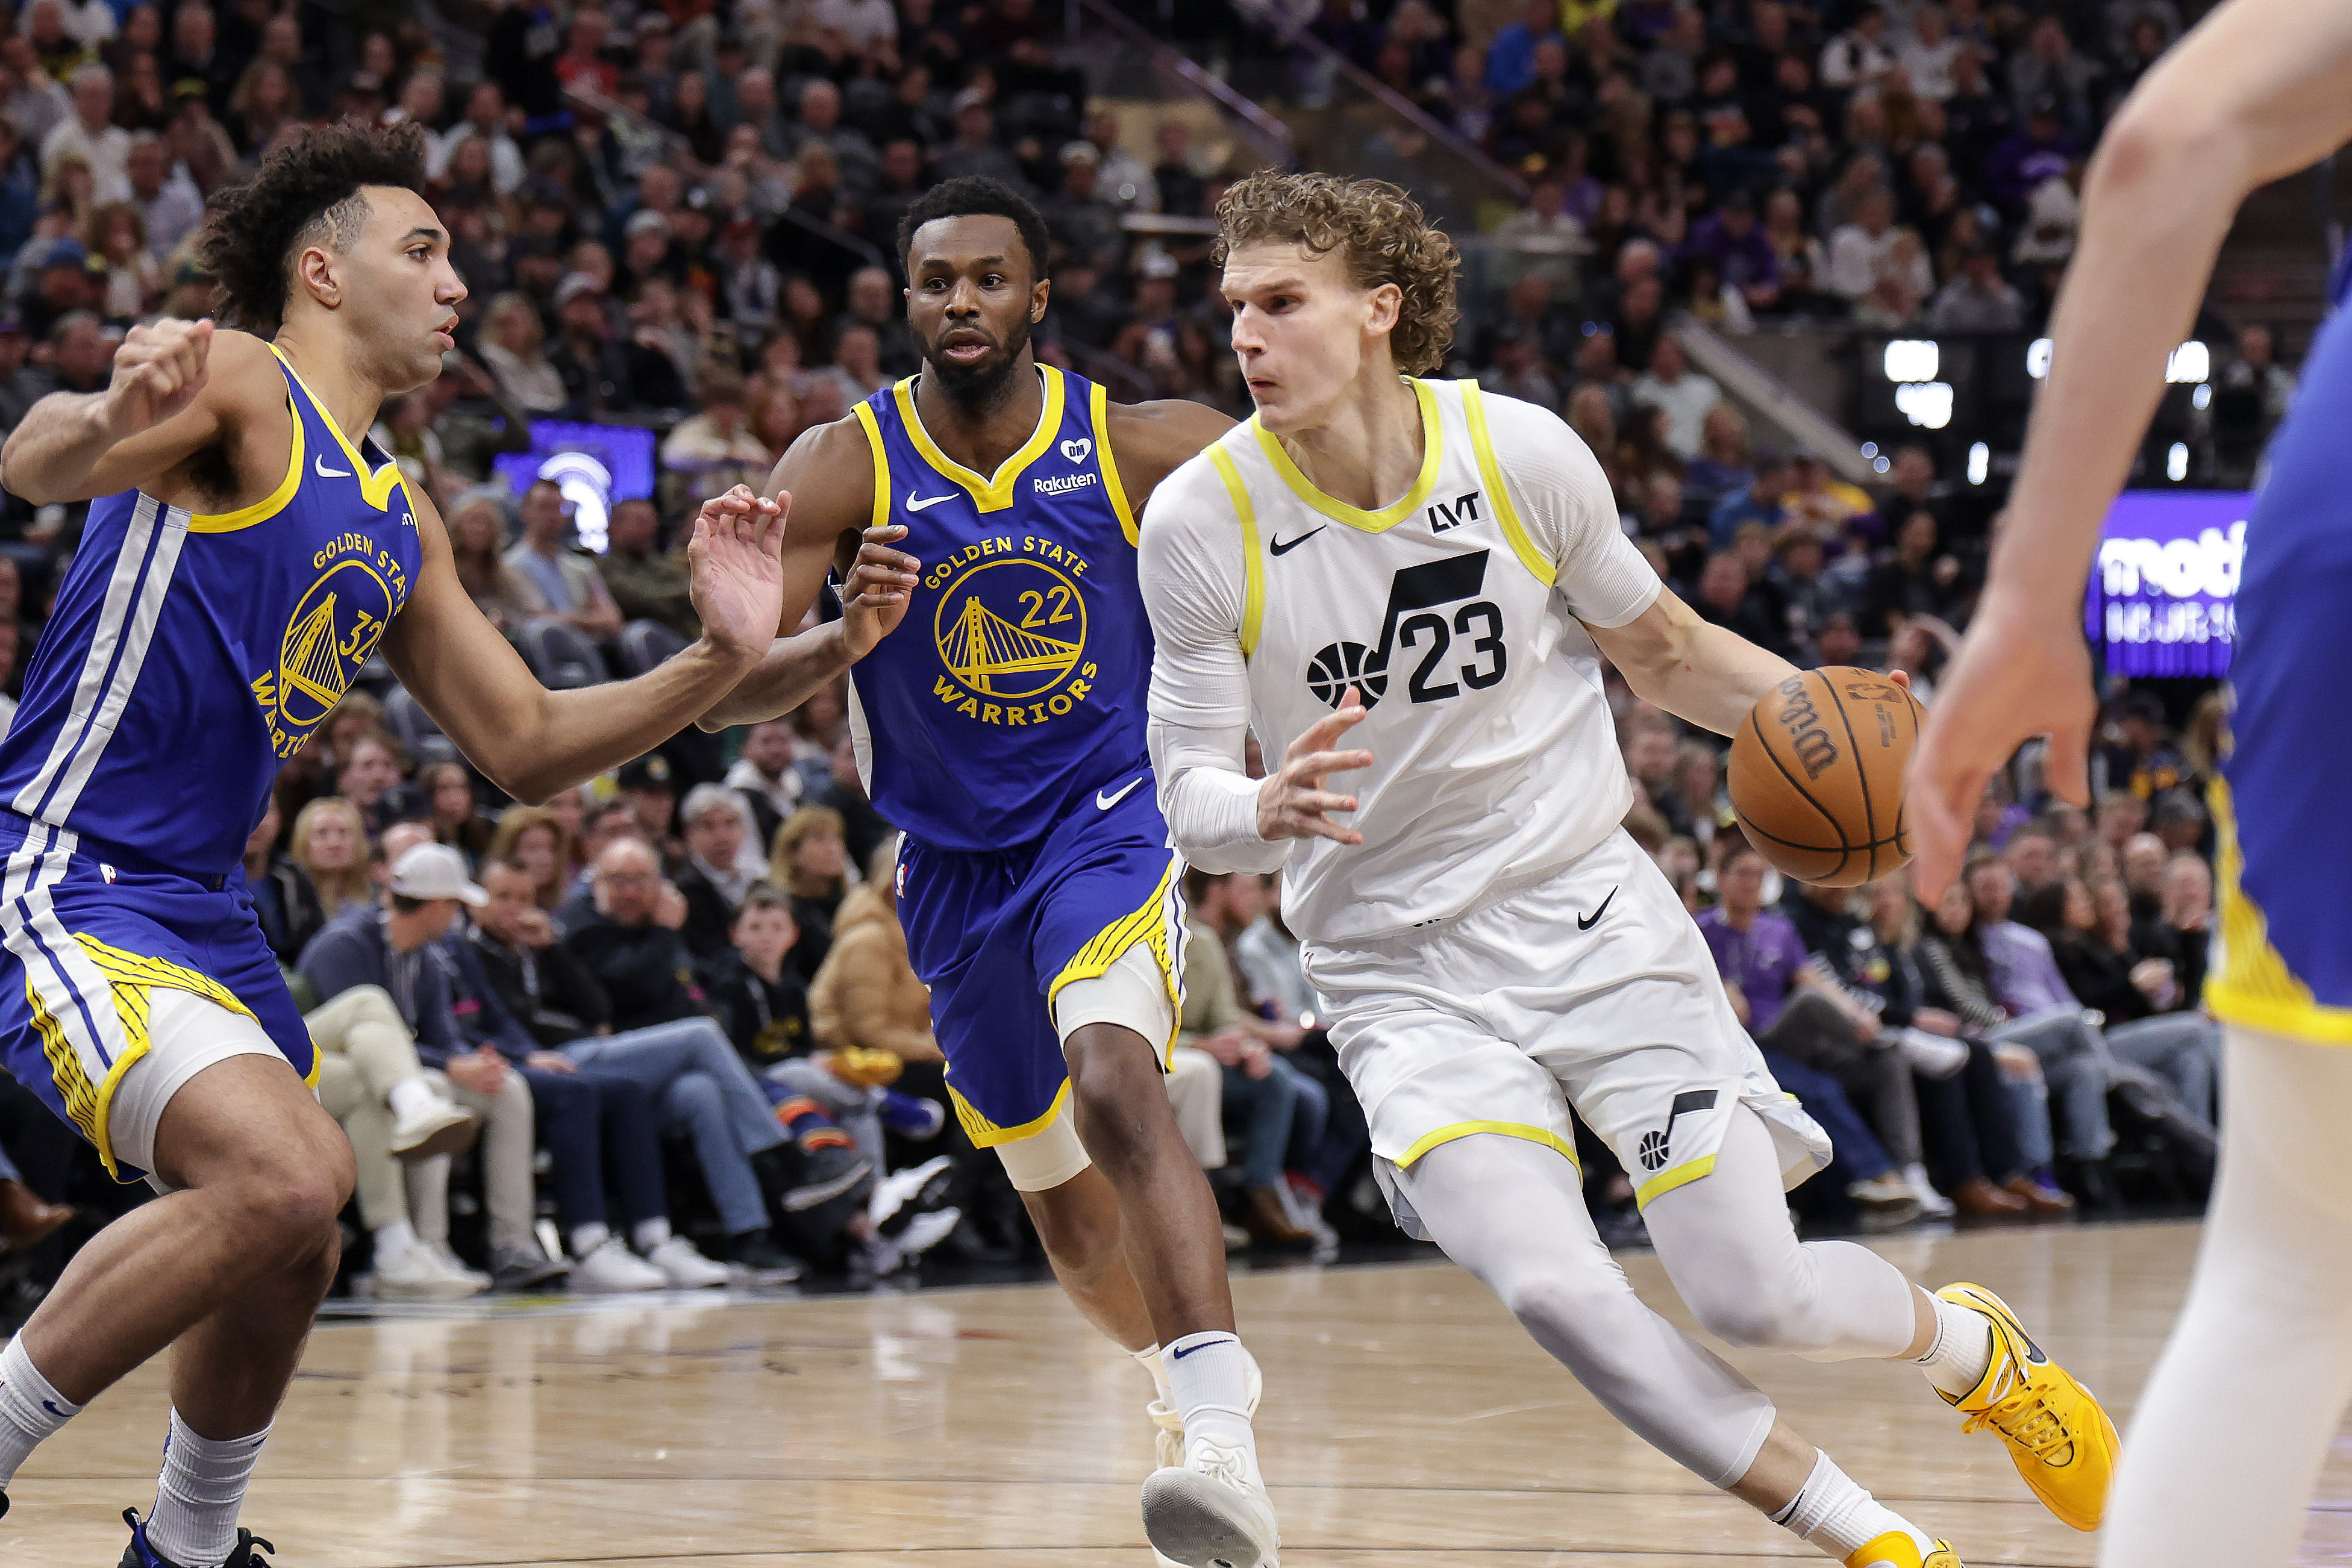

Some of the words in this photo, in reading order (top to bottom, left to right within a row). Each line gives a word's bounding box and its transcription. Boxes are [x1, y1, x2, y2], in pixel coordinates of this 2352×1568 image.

[1068, 444, 1085, 458] DM
[1034, 471, 1097, 494] Rakuten
[1427, 490, 1480, 534] LVT
[313, 533, 373, 570] GOLDEN
[925, 536, 1013, 590] GOLDEN
[1023, 535, 1089, 578] STATE
[1018, 586, 1074, 629] 22
[339, 610, 383, 664] 32
[1399, 601, 1507, 704] 23
[933, 660, 1098, 726] WARRIORS
